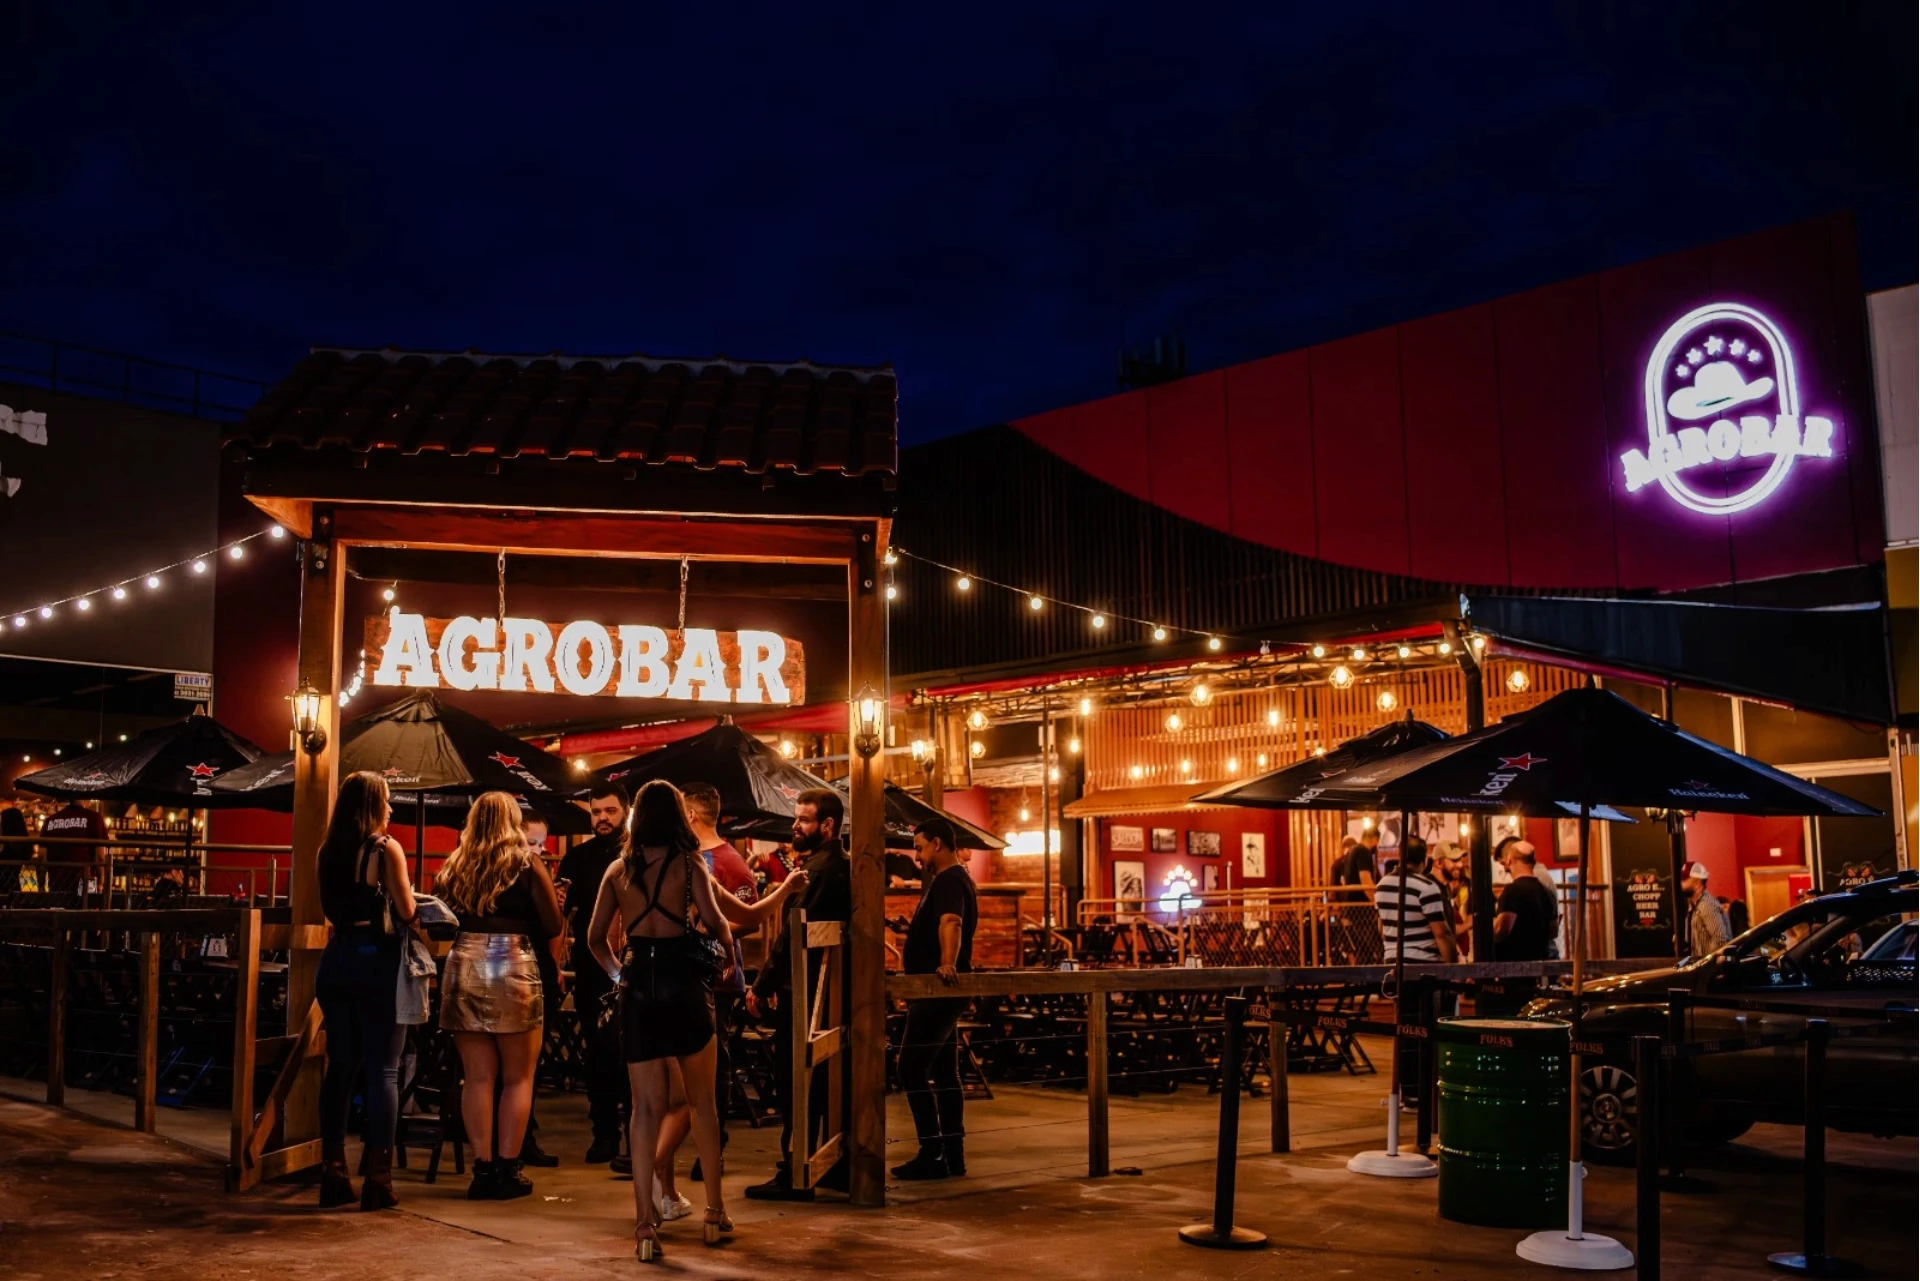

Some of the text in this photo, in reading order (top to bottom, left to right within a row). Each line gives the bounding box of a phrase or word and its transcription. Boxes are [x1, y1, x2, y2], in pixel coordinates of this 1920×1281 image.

[1620, 414, 1833, 493] AGROBAR
[373, 613, 791, 704] AGROBAR
[1317, 1016, 1348, 1029] FOLKS
[1396, 1024, 1429, 1038] FOLKS
[1479, 1033, 1515, 1049] FOLKS
[1568, 1040, 1606, 1055] FOLKS
